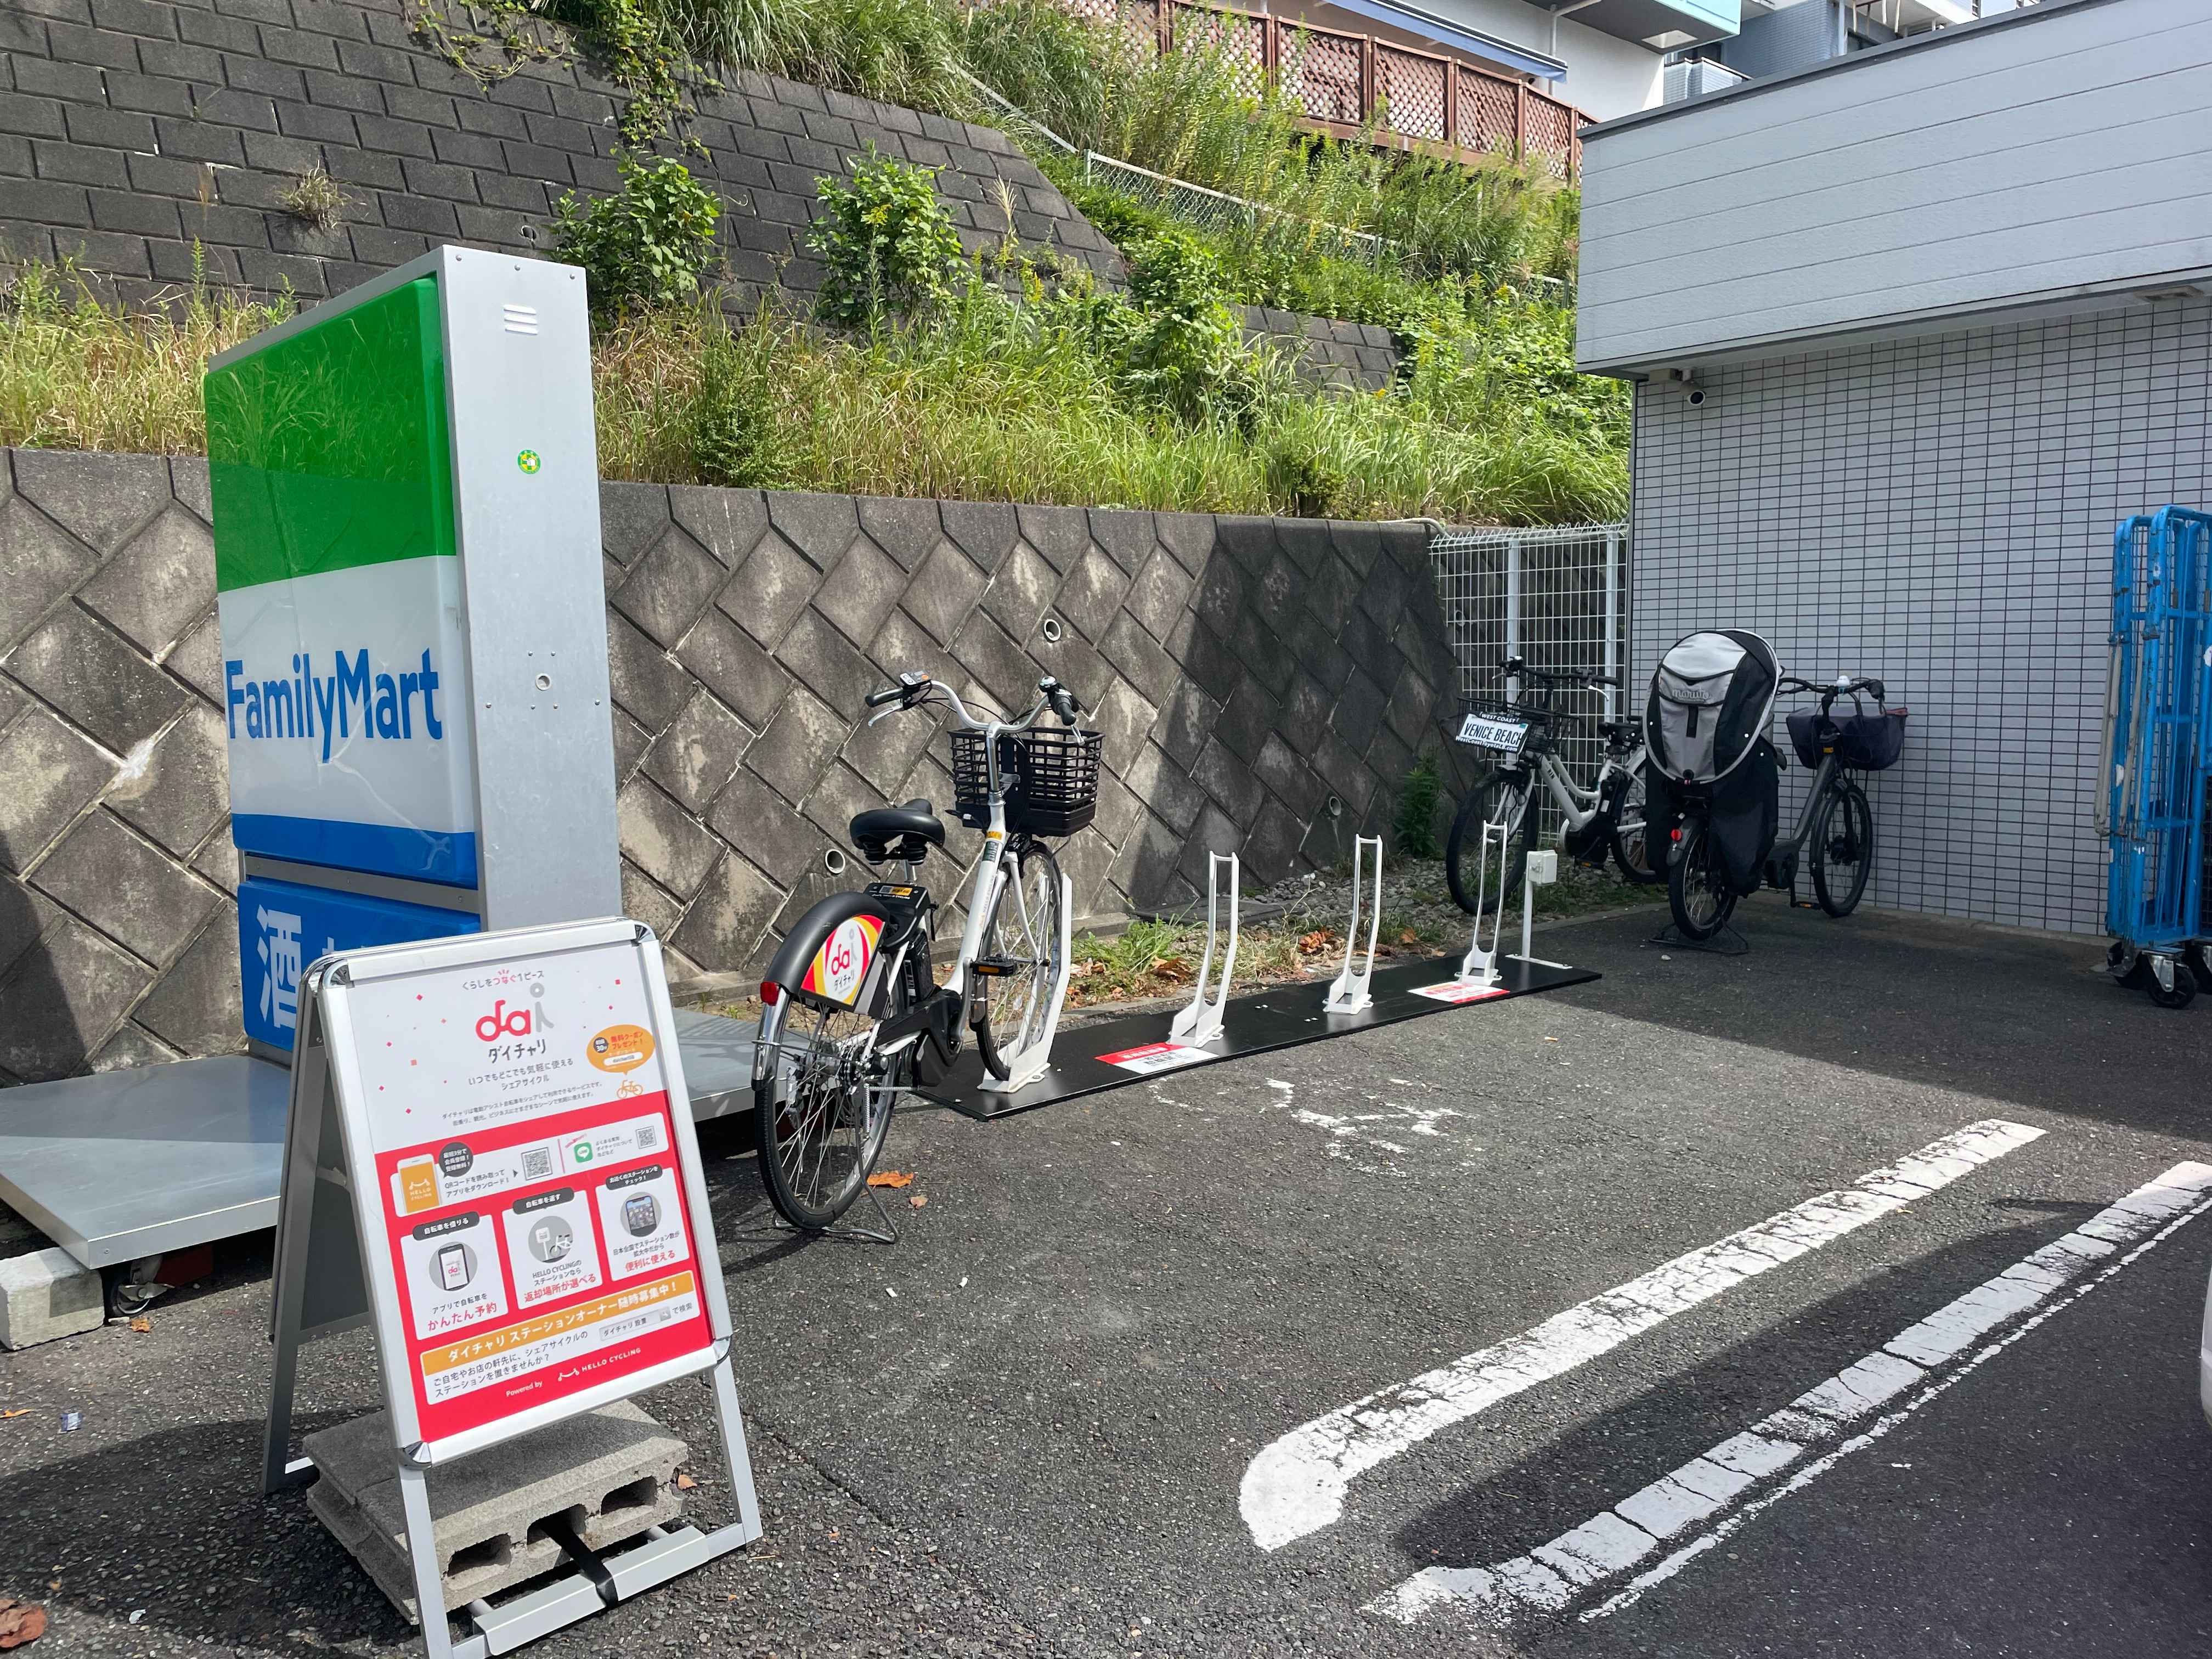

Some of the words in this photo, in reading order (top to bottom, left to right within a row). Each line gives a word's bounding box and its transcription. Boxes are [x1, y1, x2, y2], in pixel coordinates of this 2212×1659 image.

[225, 647, 443, 764] FamilyMart
[1464, 723, 1494, 740] VENICE
[1494, 729, 1522, 745] BEACH
[256, 904, 302, 1029] 酒
[463, 970, 544, 990] くらしをつなぐ1ピース
[834, 969, 854, 991] ダイチャリ
[488, 1039, 546, 1064] ダイチャリ
[469, 1058, 573, 1085] いつでもどこでも気軽に使える
[501, 1075, 549, 1091] シェアサイクル
[444, 1169, 505, 1189] QRコードを読み取って
[424, 1217, 469, 1235] 自転車を借りる
[625, 1250, 675, 1272] 便利に使える
[532, 1268, 551, 1278] HELLO
[534, 1268, 582, 1286] ステーションなら
[524, 1273, 596, 1302] 返却場所が選べる
[432, 1293, 487, 1314] アプリで自転車を
[672, 1302, 692, 1314] で検索
[427, 1302, 497, 1331] かんたん予約
[604, 1323, 633, 1337] ダイチャリ
[433, 1330, 588, 1387] ご自宅やお店の軒先に、シェアサイクルの
[448, 1335, 505, 1362] ダイチャリ
[582, 1359, 607, 1373] HELLO
[609, 1347, 641, 1363] CYCLING
[436, 1354, 549, 1398] ステーションを置きませんか？
[506, 1383, 533, 1397] Powered
[534, 1380, 543, 1389] by
